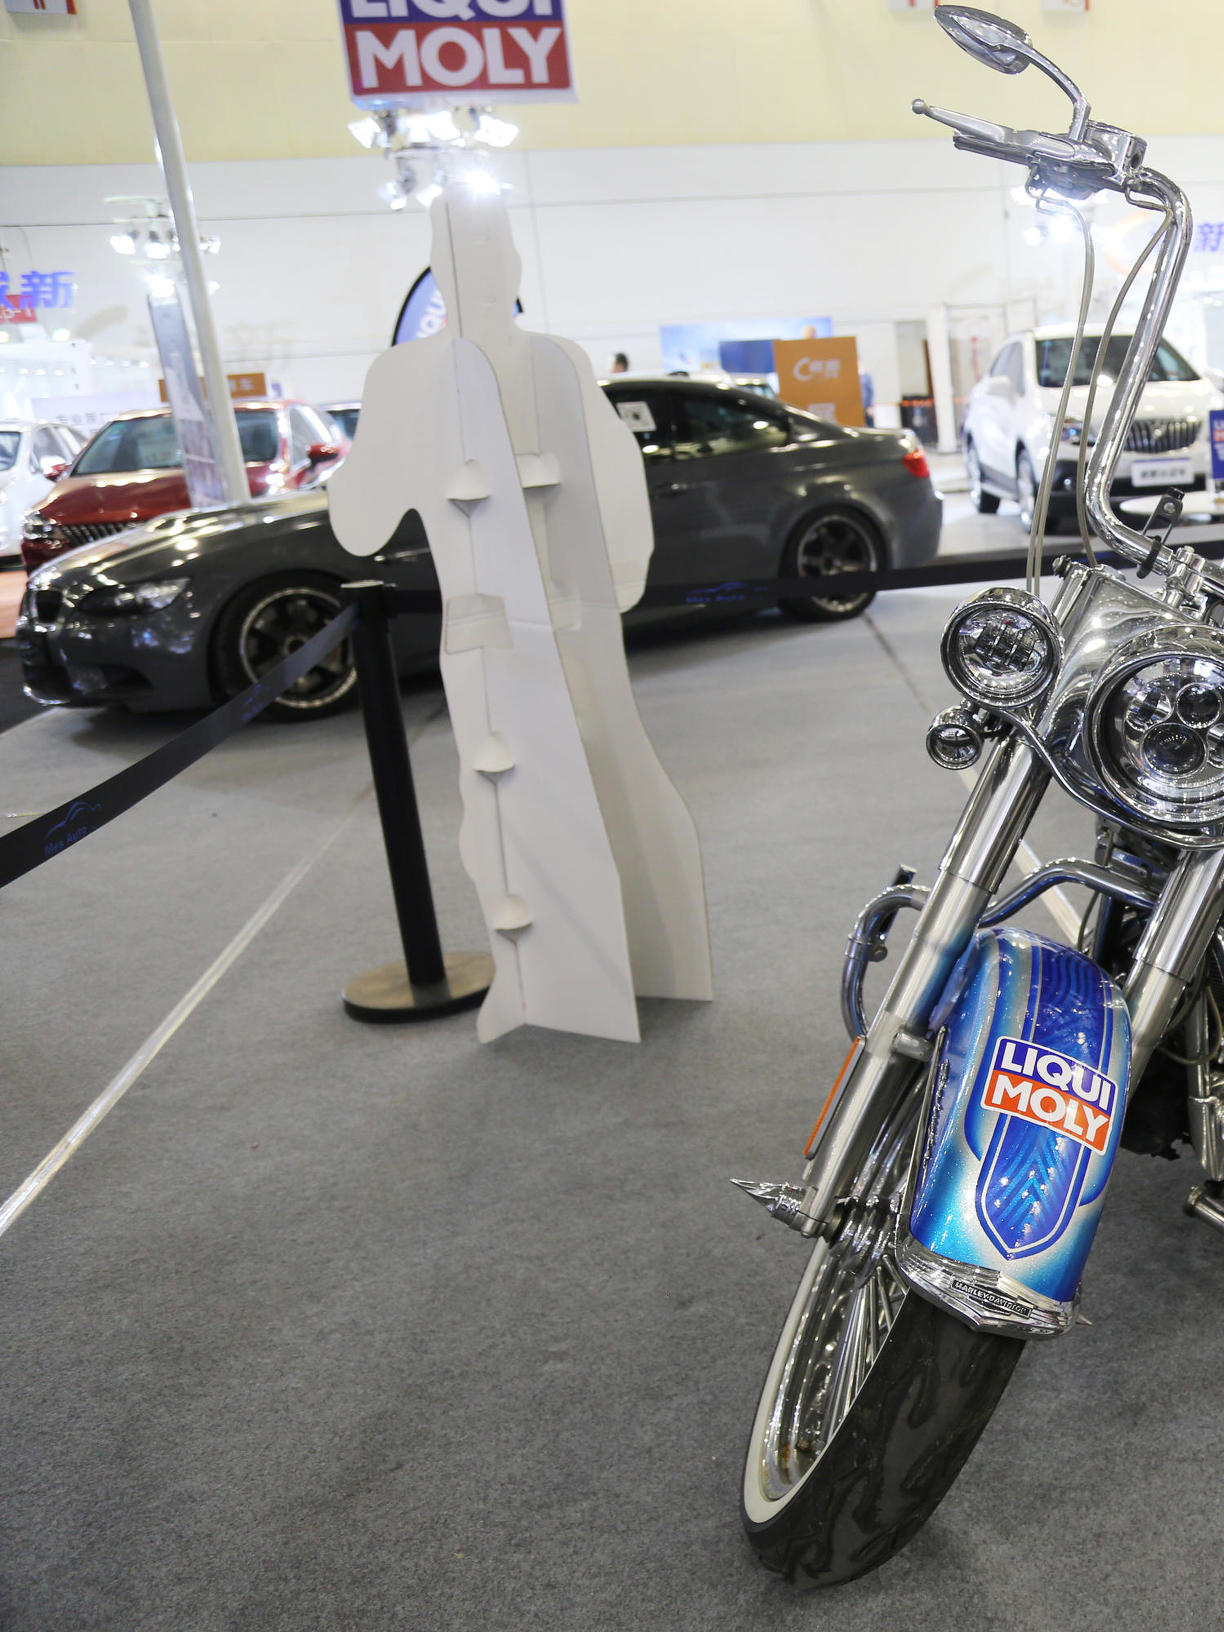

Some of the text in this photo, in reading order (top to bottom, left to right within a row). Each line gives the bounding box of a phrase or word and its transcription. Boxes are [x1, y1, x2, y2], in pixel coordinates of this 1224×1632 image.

[354, 26, 563, 89] MOLY
[0, 270, 75, 309] 新
[991, 1074, 1109, 1142] MOLY
[1000, 1042, 1112, 1111] LIQUI
[955, 1281, 1028, 1314] HARLEY-DAVIDSON
